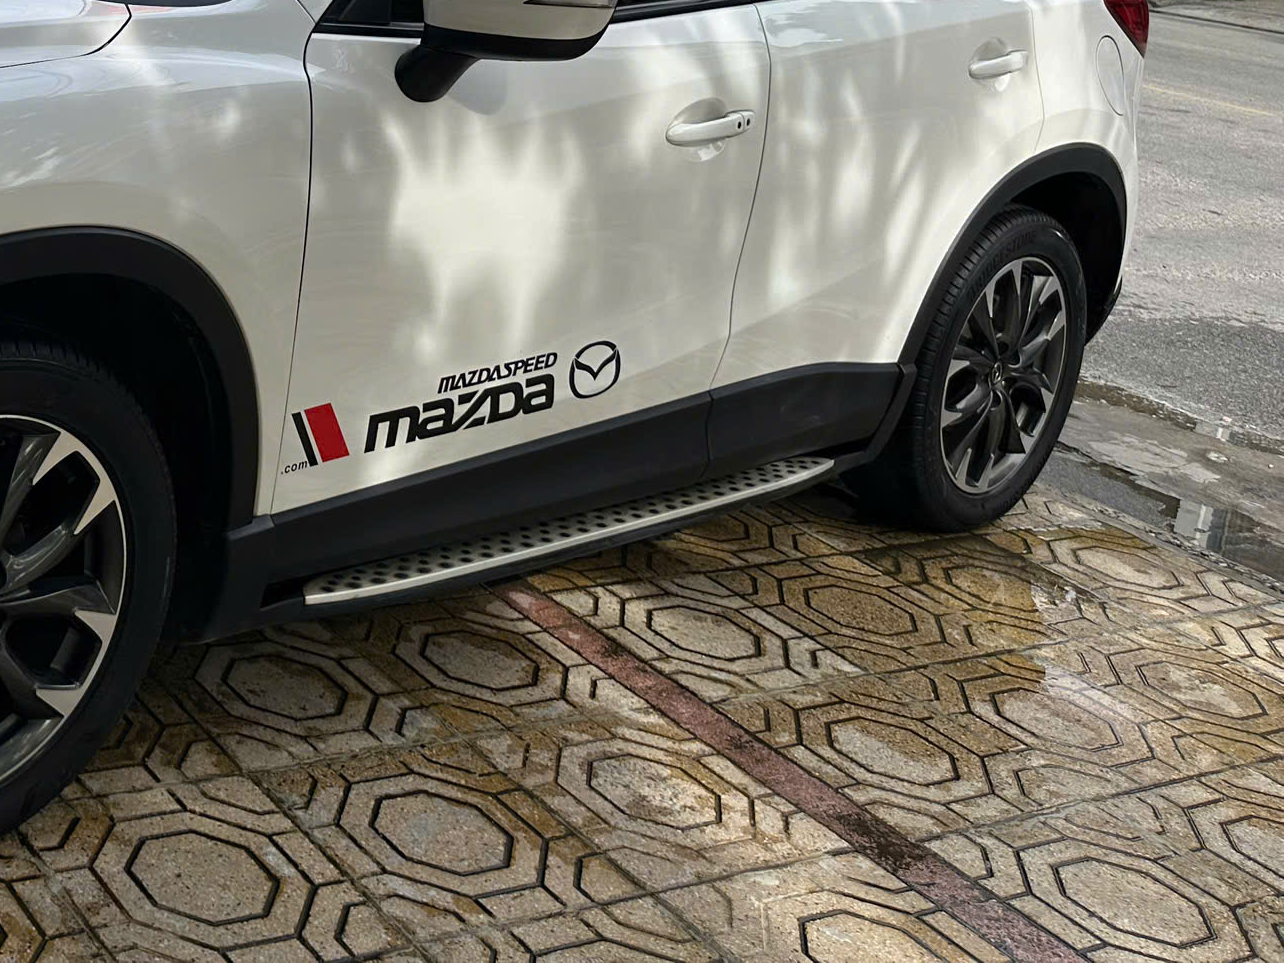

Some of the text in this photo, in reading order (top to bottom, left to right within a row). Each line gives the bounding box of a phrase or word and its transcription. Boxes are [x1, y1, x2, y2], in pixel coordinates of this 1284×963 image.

[438, 352, 558, 395] MAZDASPEED
[364, 374, 555, 454] mazda
[281, 460, 308, 475] .com
